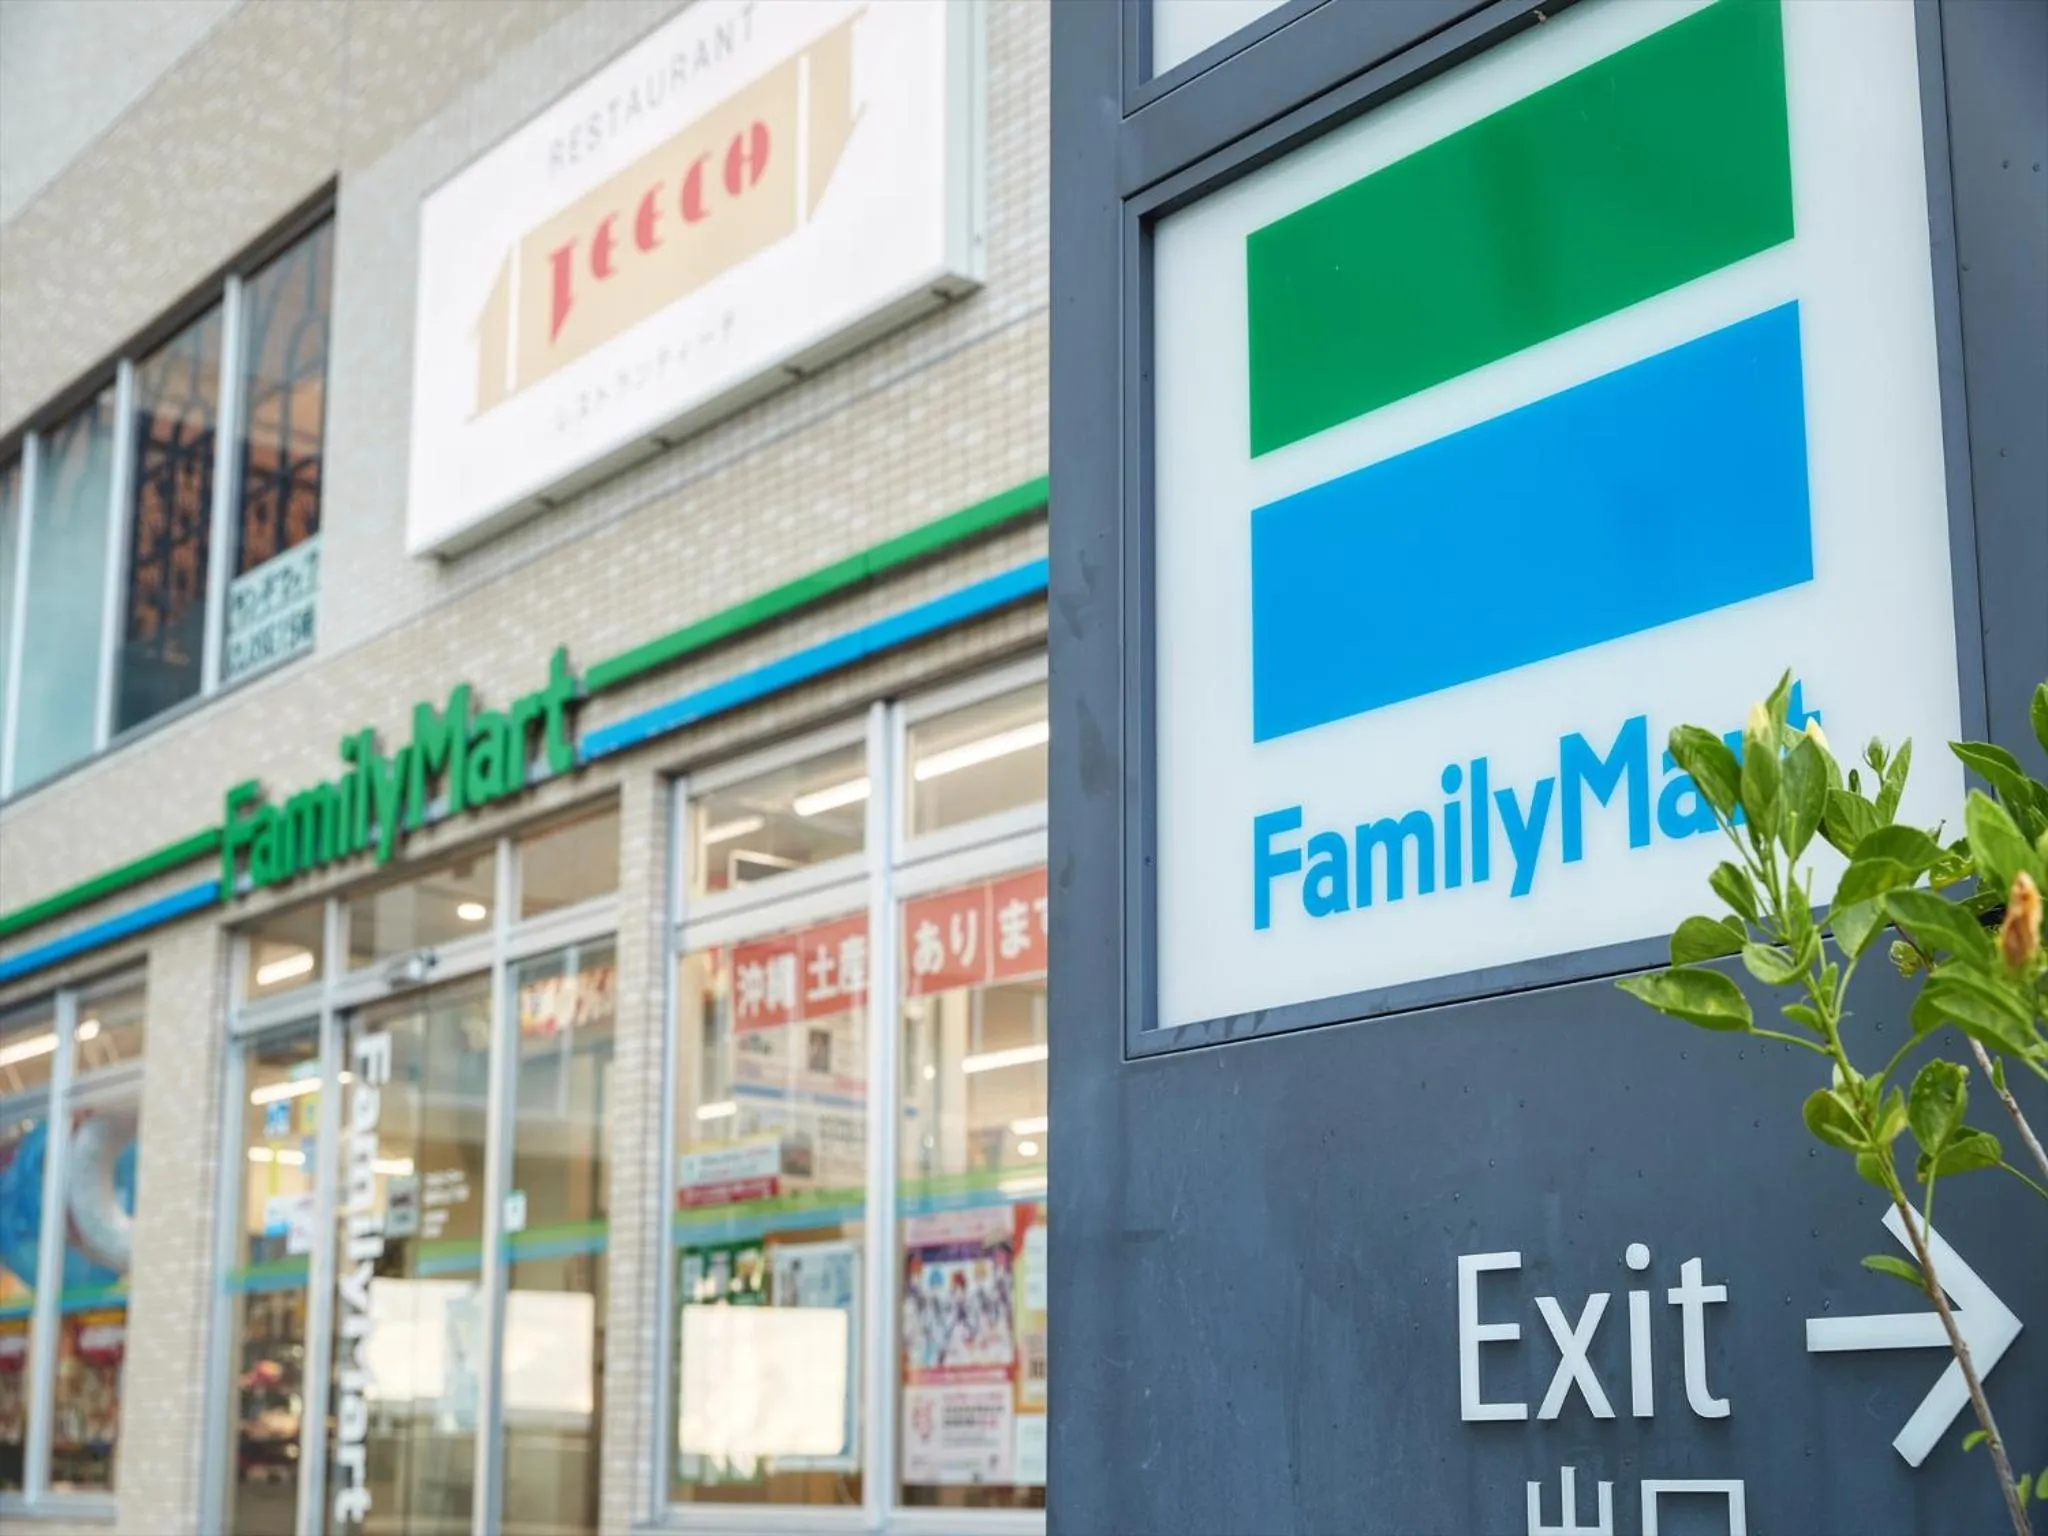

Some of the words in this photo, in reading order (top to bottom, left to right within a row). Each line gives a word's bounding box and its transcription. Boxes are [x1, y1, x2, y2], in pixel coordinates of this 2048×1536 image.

[547, 2, 758, 175] RESTAURANT
[220, 645, 576, 901] FamilyMart
[1253, 679, 1821, 931] FamilyMa
[1458, 1243, 1731, 1421] Exit
